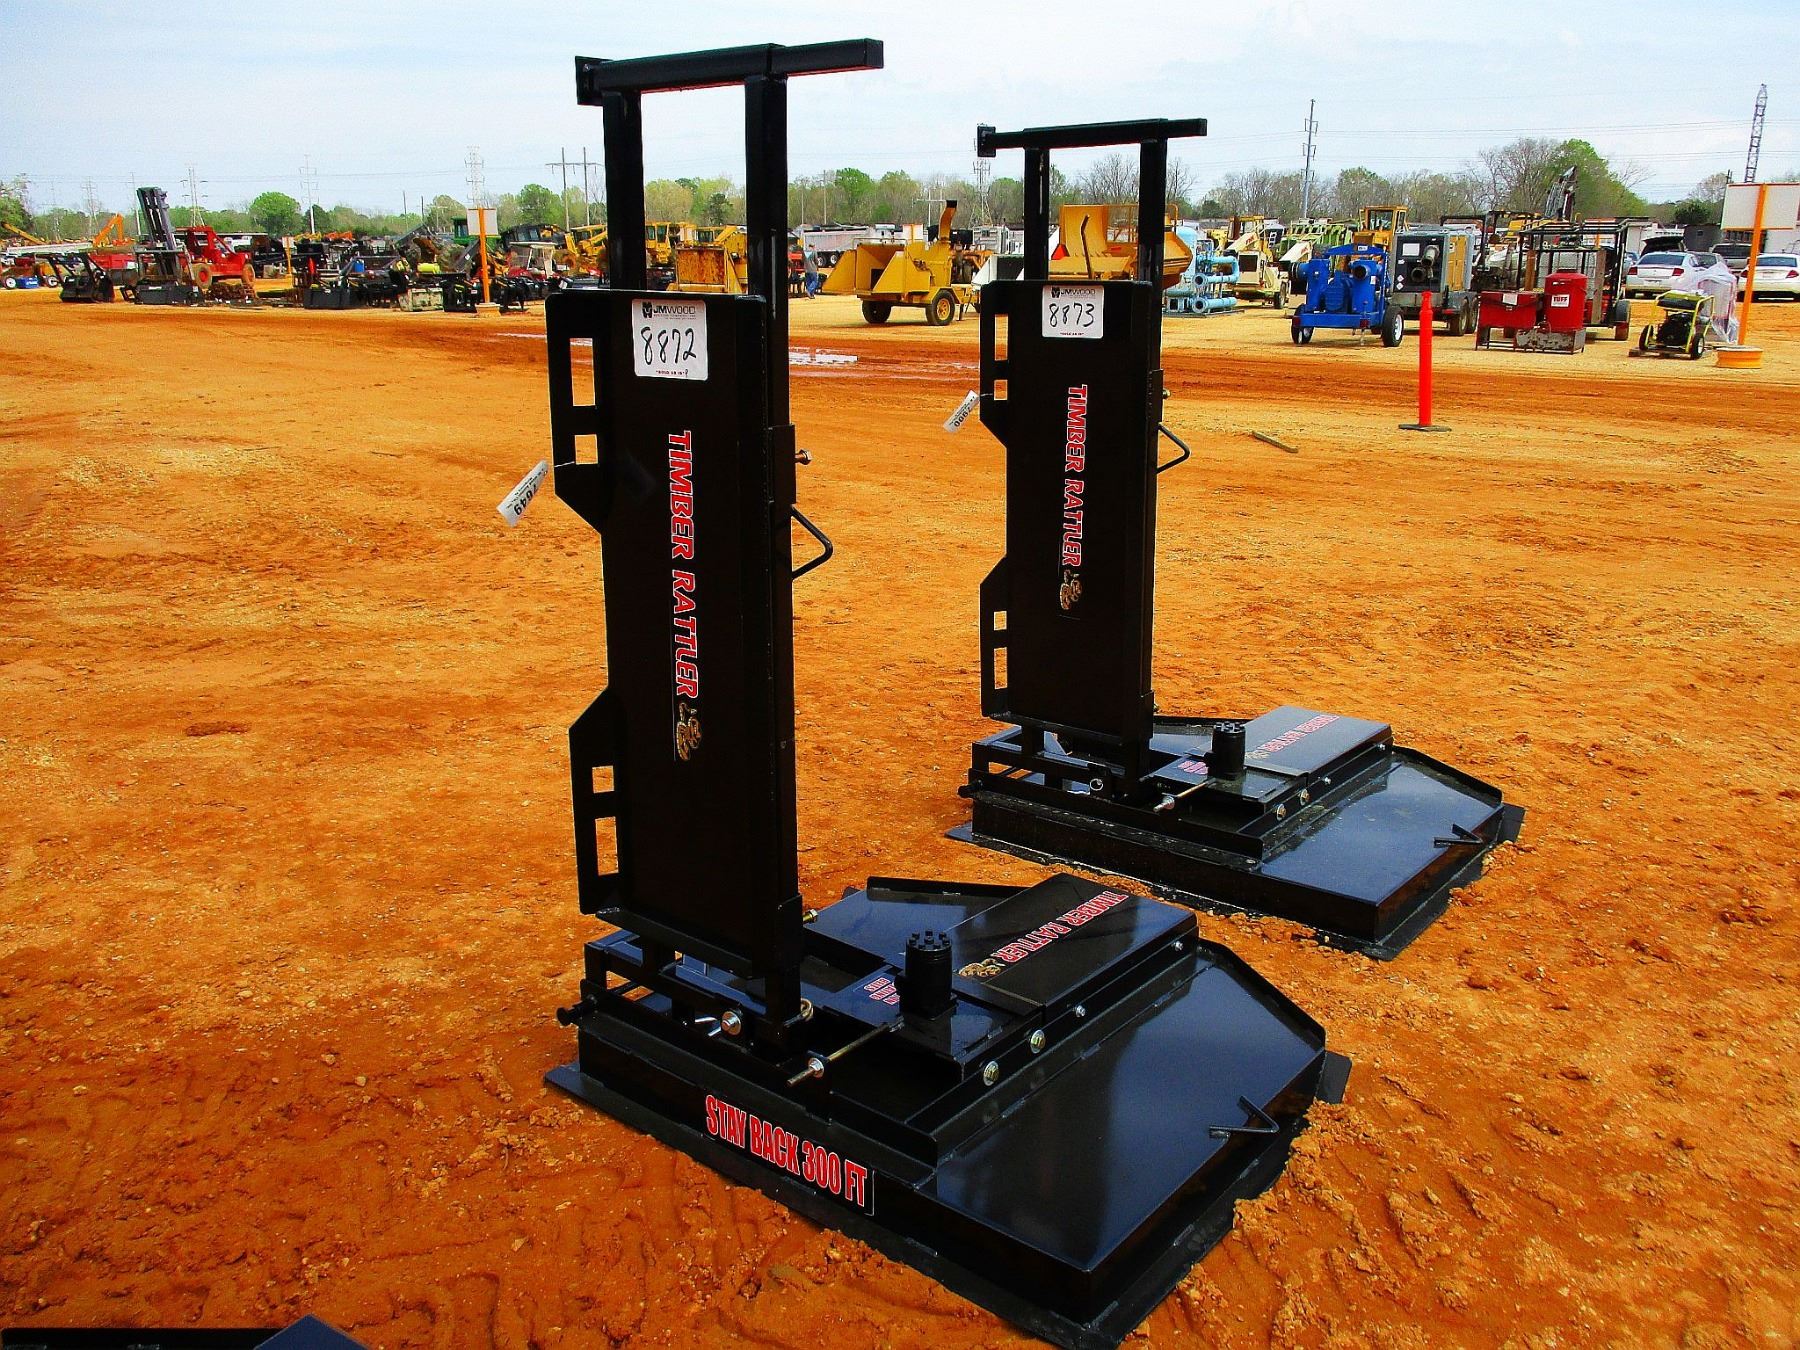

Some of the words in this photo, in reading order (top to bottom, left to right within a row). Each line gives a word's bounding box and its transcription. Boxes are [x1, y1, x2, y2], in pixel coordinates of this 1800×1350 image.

[640, 327, 697, 365] 8872
[1049, 302, 1095, 327] 8873
[1065, 384, 1088, 473] TIMBER
[668, 430, 695, 560] TIMBER
[1062, 478, 1085, 567] RATTLER
[672, 569, 699, 699] RATTLER
[990, 921, 1071, 963] RATTLER
[1056, 891, 1130, 926] TIMBER
[705, 1094, 747, 1149] STAY
[749, 1114, 801, 1176] BACK
[802, 1140, 842, 1195] 300
[844, 1159, 868, 1208] FT
